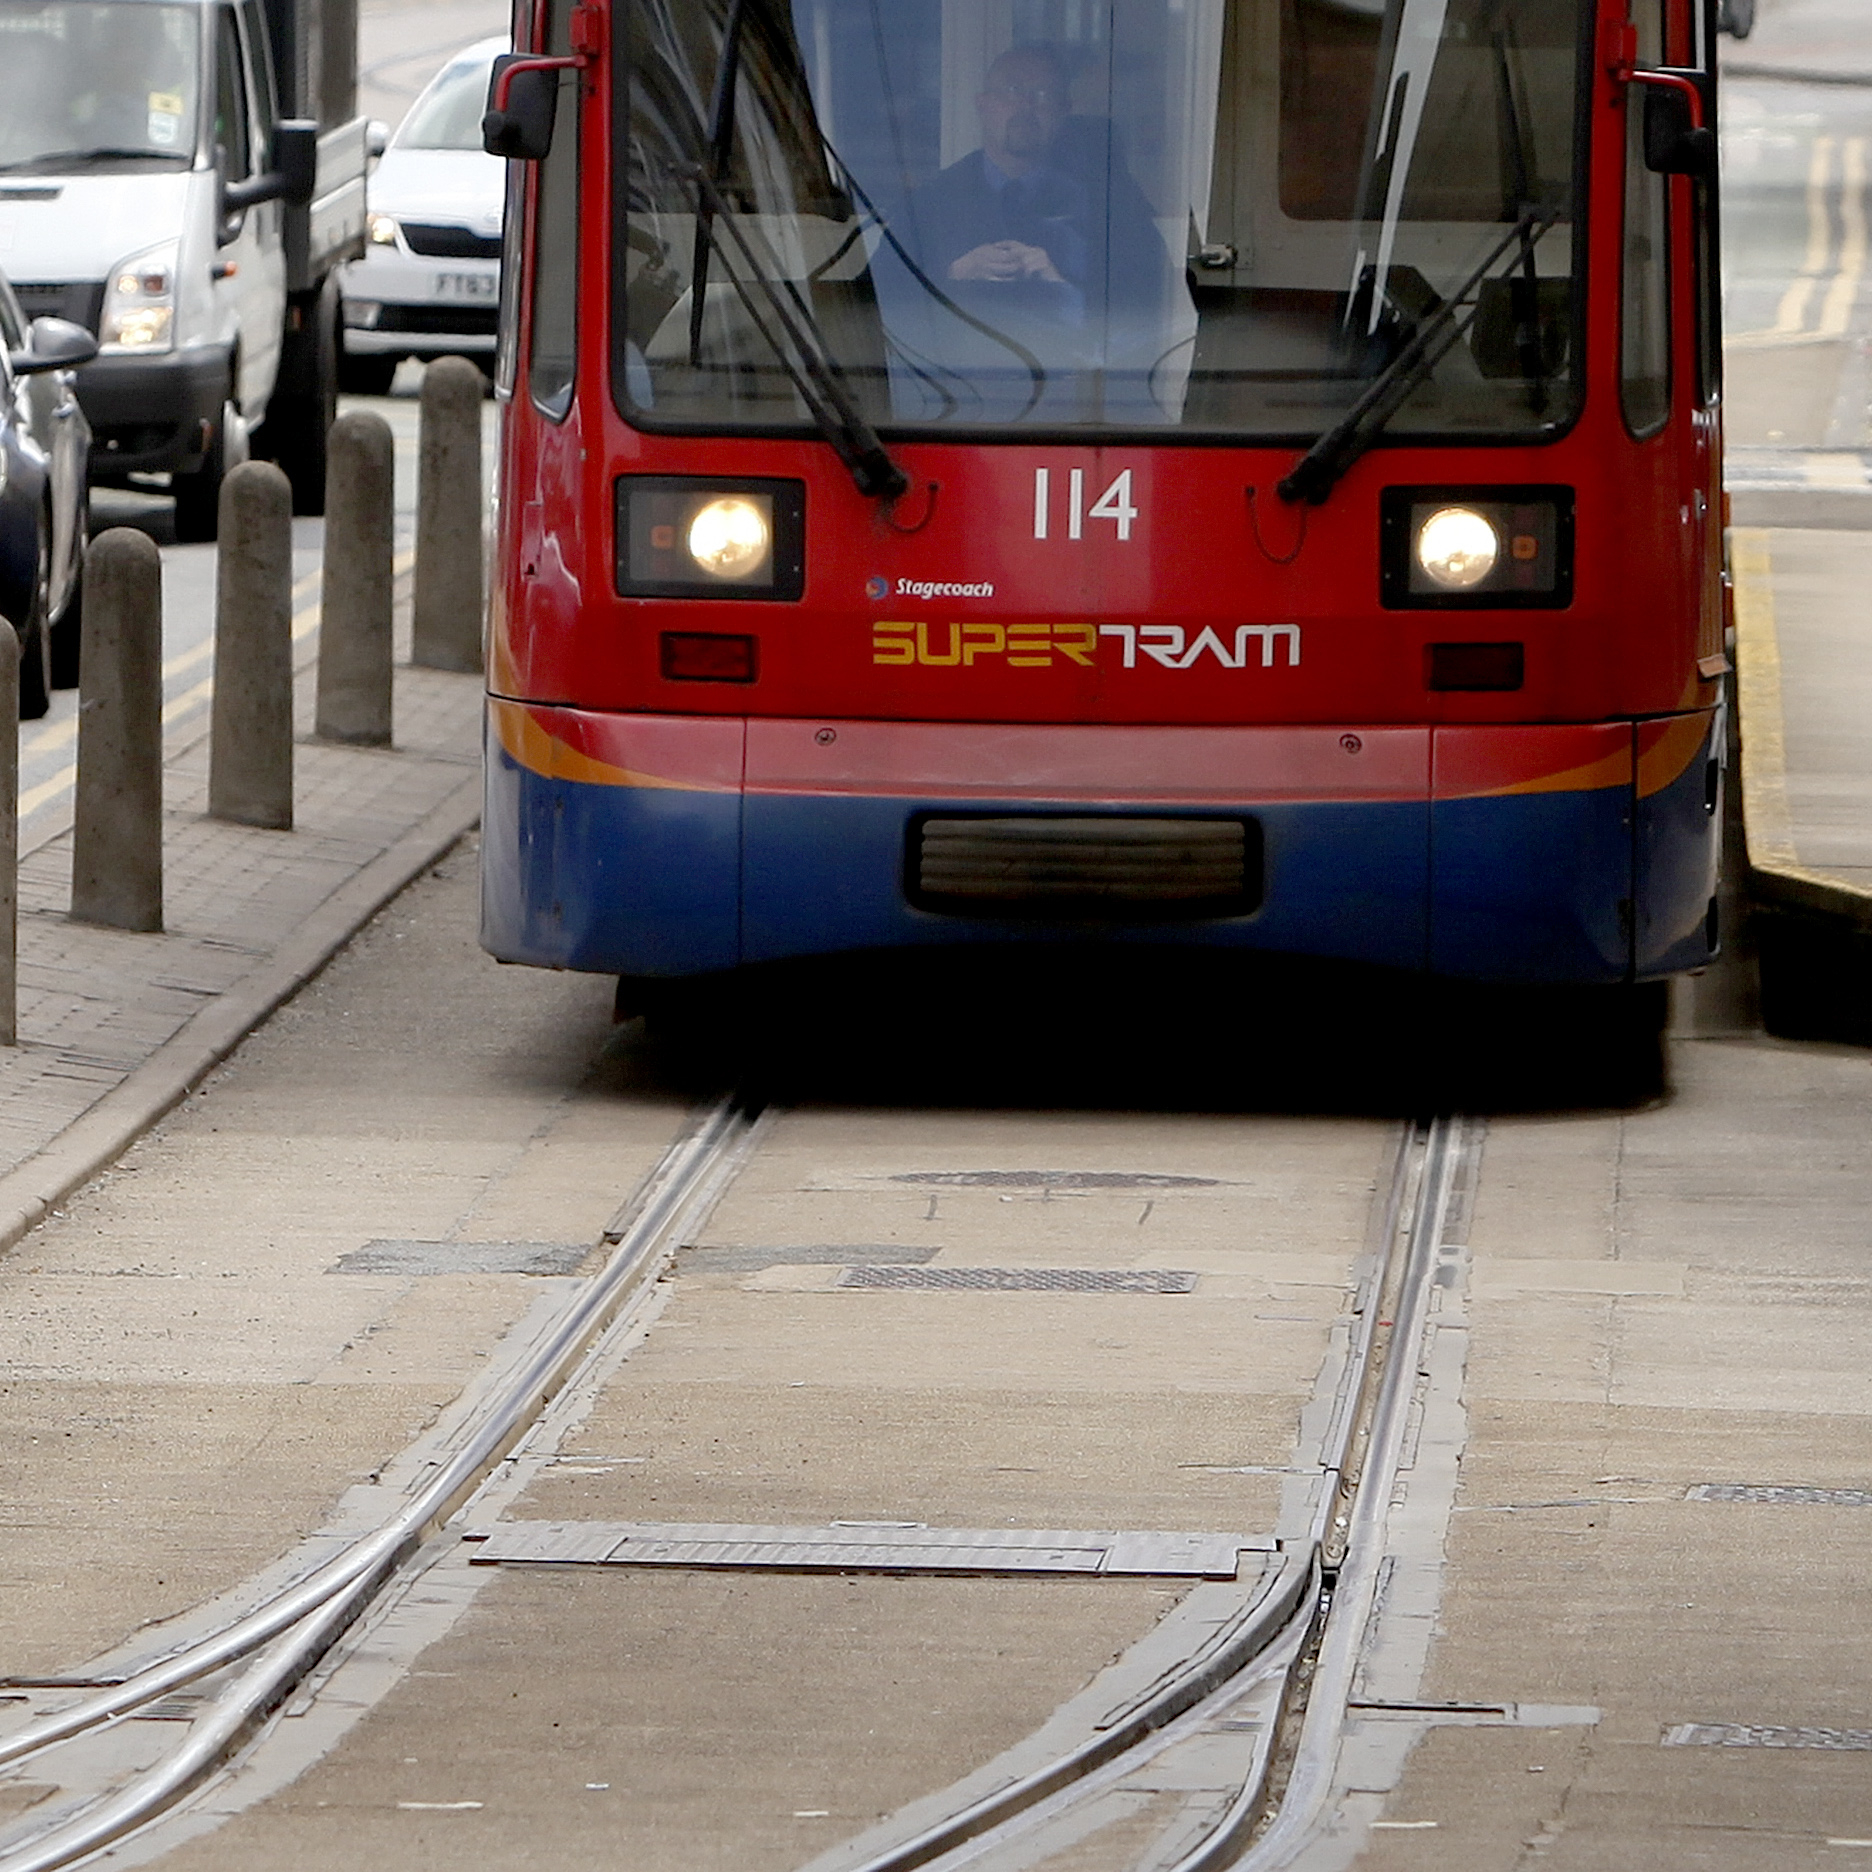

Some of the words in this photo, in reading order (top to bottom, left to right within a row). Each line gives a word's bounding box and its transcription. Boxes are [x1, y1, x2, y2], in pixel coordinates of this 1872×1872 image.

[1032, 466, 1139, 541] 114
[896, 576, 994, 600] Stagecoach
[872, 621, 1301, 669] SUPERTRAM
